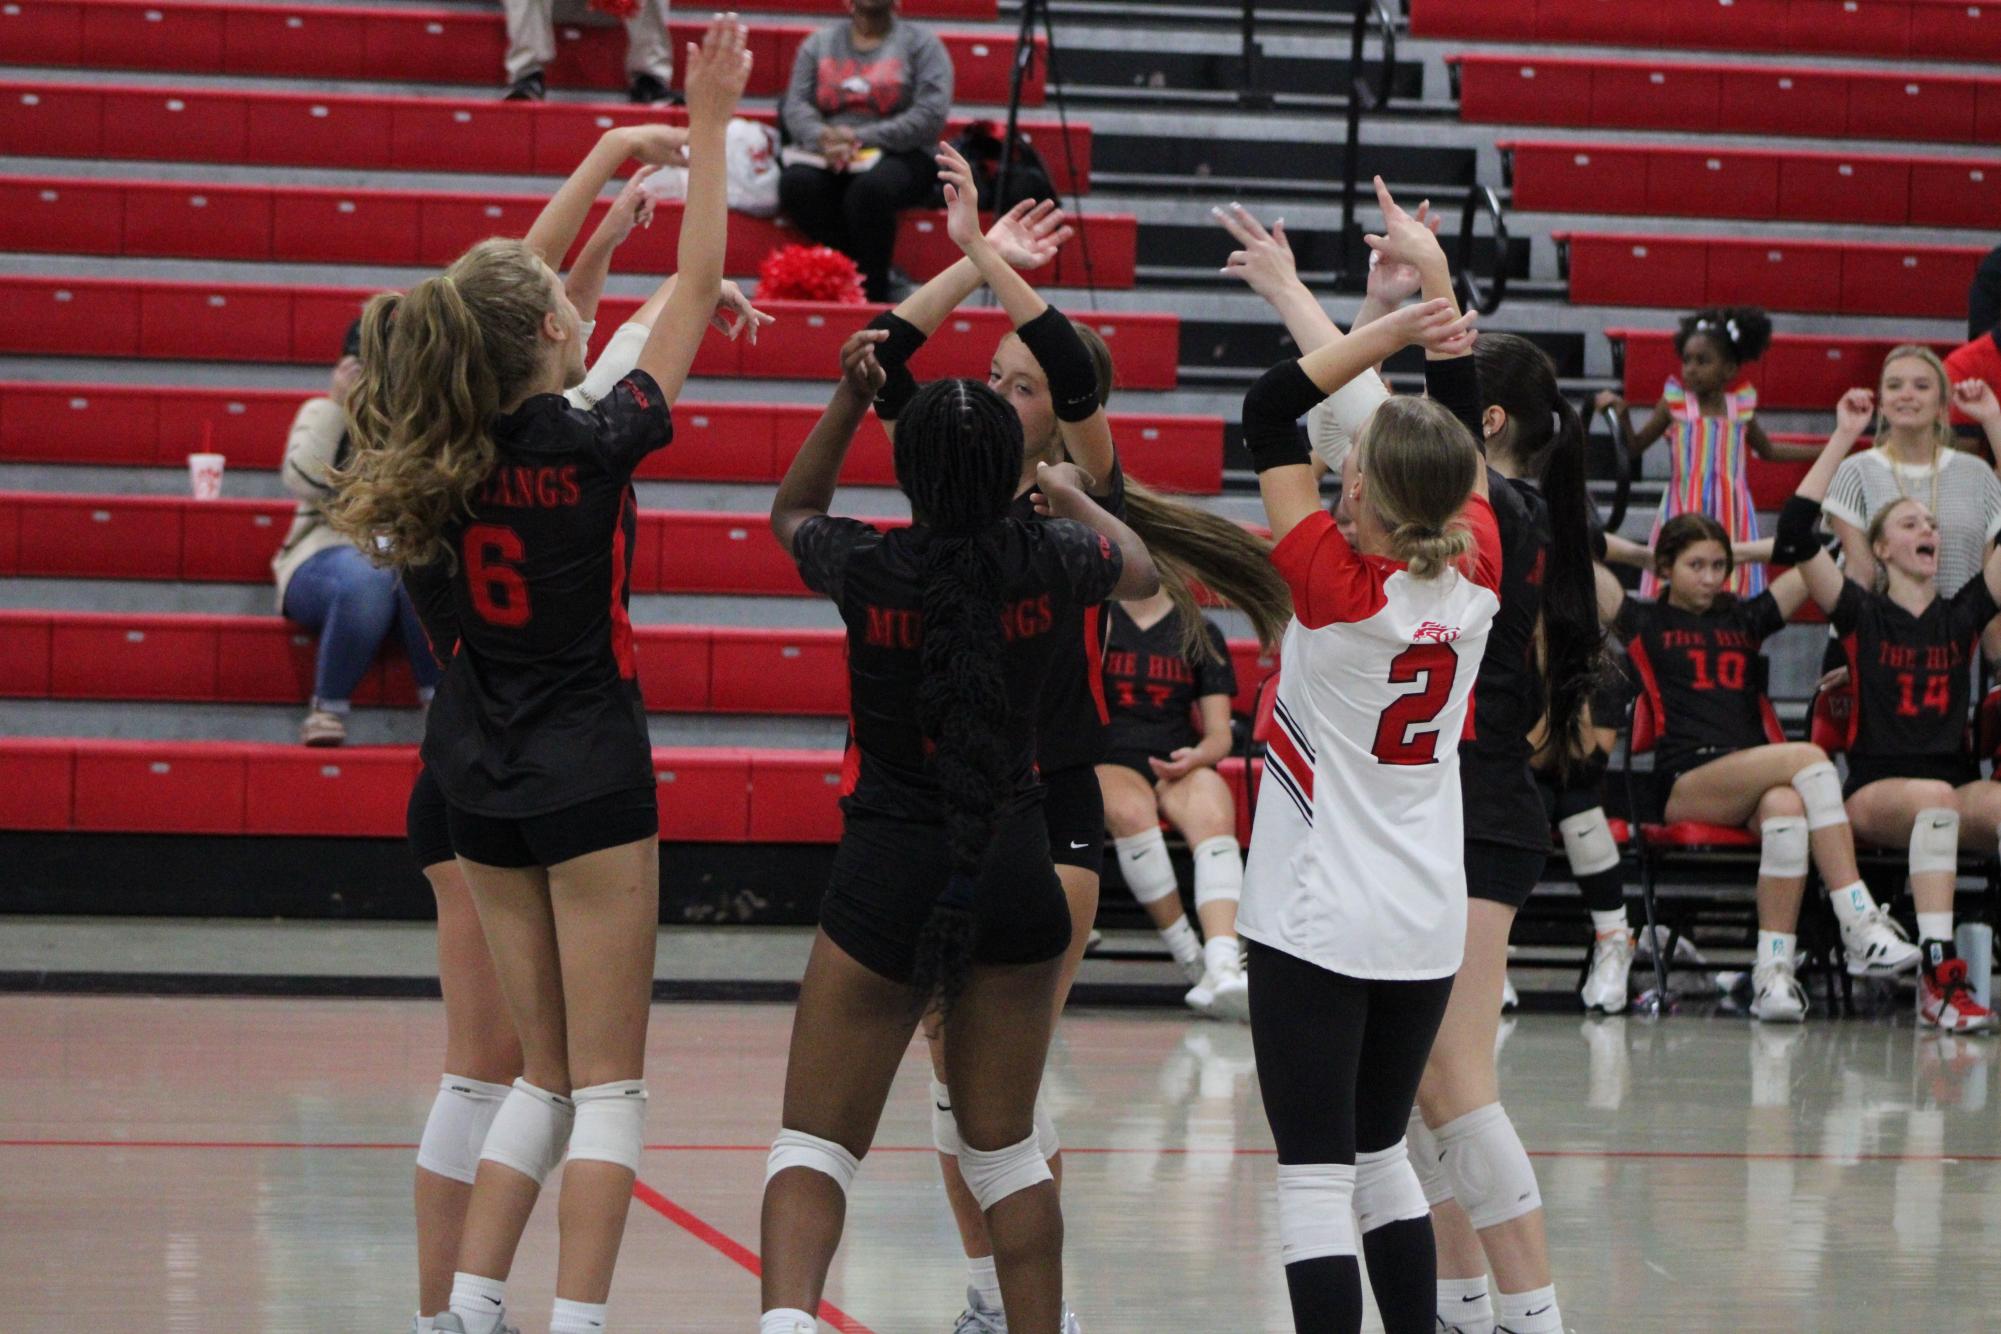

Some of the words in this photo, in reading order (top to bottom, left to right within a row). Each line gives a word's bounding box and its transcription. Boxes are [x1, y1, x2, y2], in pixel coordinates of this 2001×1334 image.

[462, 523, 532, 627] 6
[1107, 651, 1137, 676] HE
[1686, 648, 1747, 689] 10
[1114, 681, 1174, 708] 17
[1371, 642, 1458, 765] 2
[1896, 672, 1951, 716] 14
